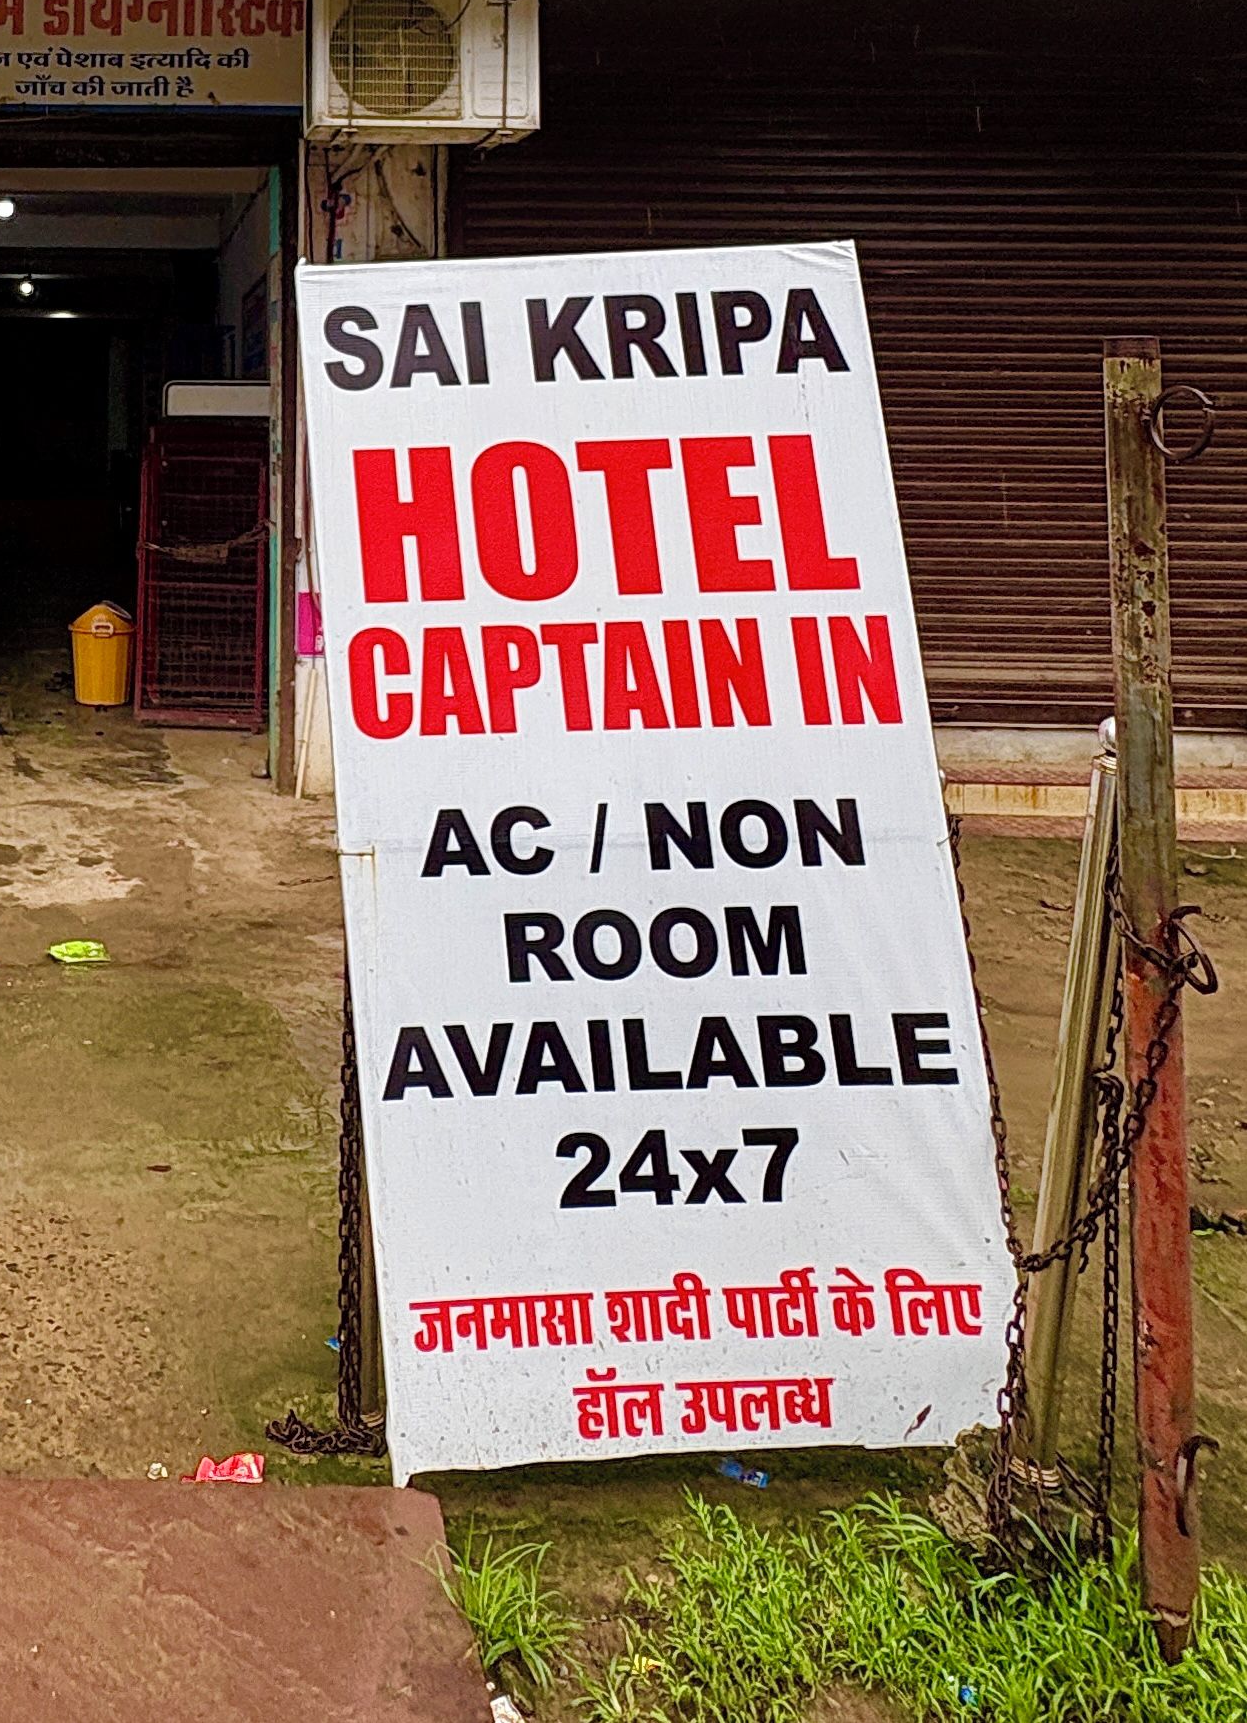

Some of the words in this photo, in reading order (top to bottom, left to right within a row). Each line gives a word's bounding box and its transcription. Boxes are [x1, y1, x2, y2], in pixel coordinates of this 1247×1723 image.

[14, 73, 67, 97] जाँच
[71, 75, 106, 97] की
[110, 75, 171, 98] जाती
[174, 75, 195, 99] है
[17, 47, 54, 69] एवं
[55, 47, 125, 70] पेशाब
[130, 47, 213, 71] इत्यादि
[216, 47, 251, 70] की
[322, 301, 490, 392] SAI
[526, 288, 852, 383] KRIPA
[352, 434, 861, 603] HOTEL
[347, 617, 774, 740] CAPTAIN
[791, 614, 904, 727] IN
[420, 805, 556, 878] AC
[588, 802, 610, 875] /
[643, 797, 868, 872] NON
[502, 905, 809, 984] ROOM
[381, 1012, 960, 1102] AVAILABLE
[555, 1127, 801, 1210] 24x7
[409, 1291, 595, 1354] जनमासा
[604, 1272, 711, 1344] शादी
[720, 1265, 821, 1340] पार्टी
[827, 1265, 876, 1338] के
[884, 1267, 983, 1338] लिए
[572, 1367, 665, 1441] हॉल
[674, 1376, 836, 1435] उपलब्ध
